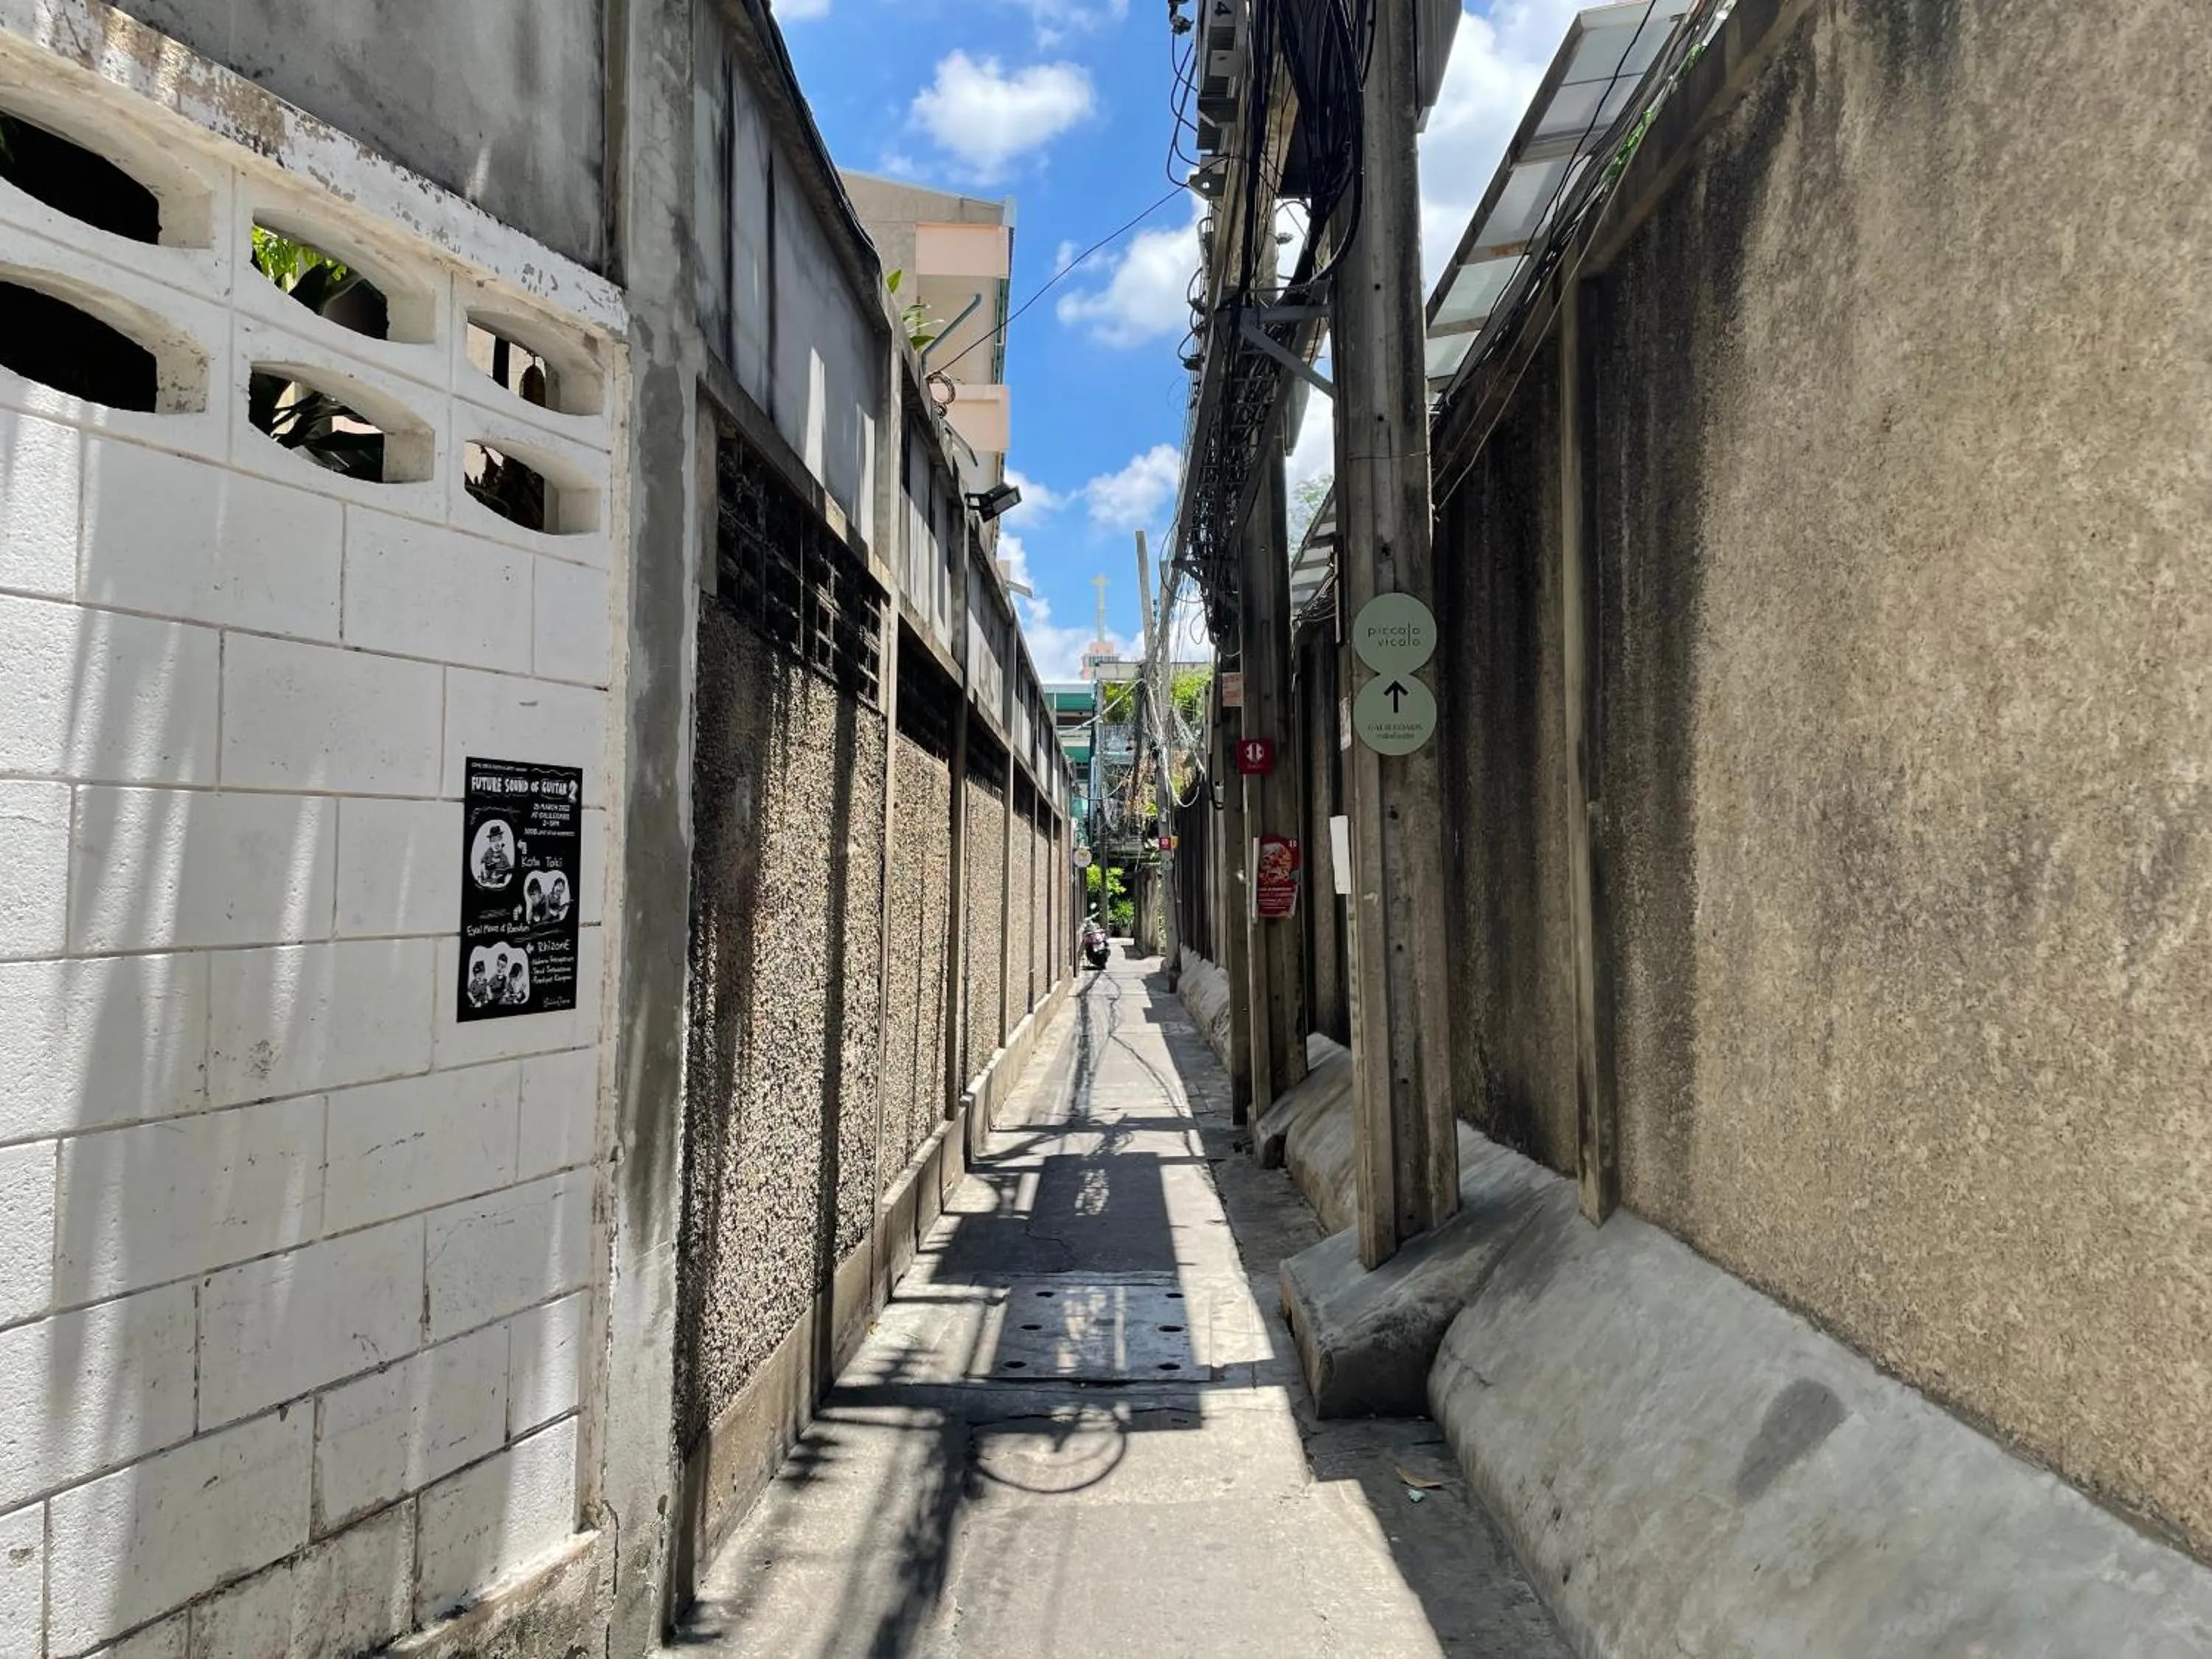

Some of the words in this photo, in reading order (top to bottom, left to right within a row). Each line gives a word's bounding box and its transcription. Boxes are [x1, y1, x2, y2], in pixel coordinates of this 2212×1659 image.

[1368, 622, 1421, 637] piccolo
[1378, 636, 1421, 647] vicolo
[471, 776, 502, 793] FUTURE
[504, 778, 529, 793] SOUND
[530, 781, 540, 793] OF
[542, 781, 567, 795] GUITAR
